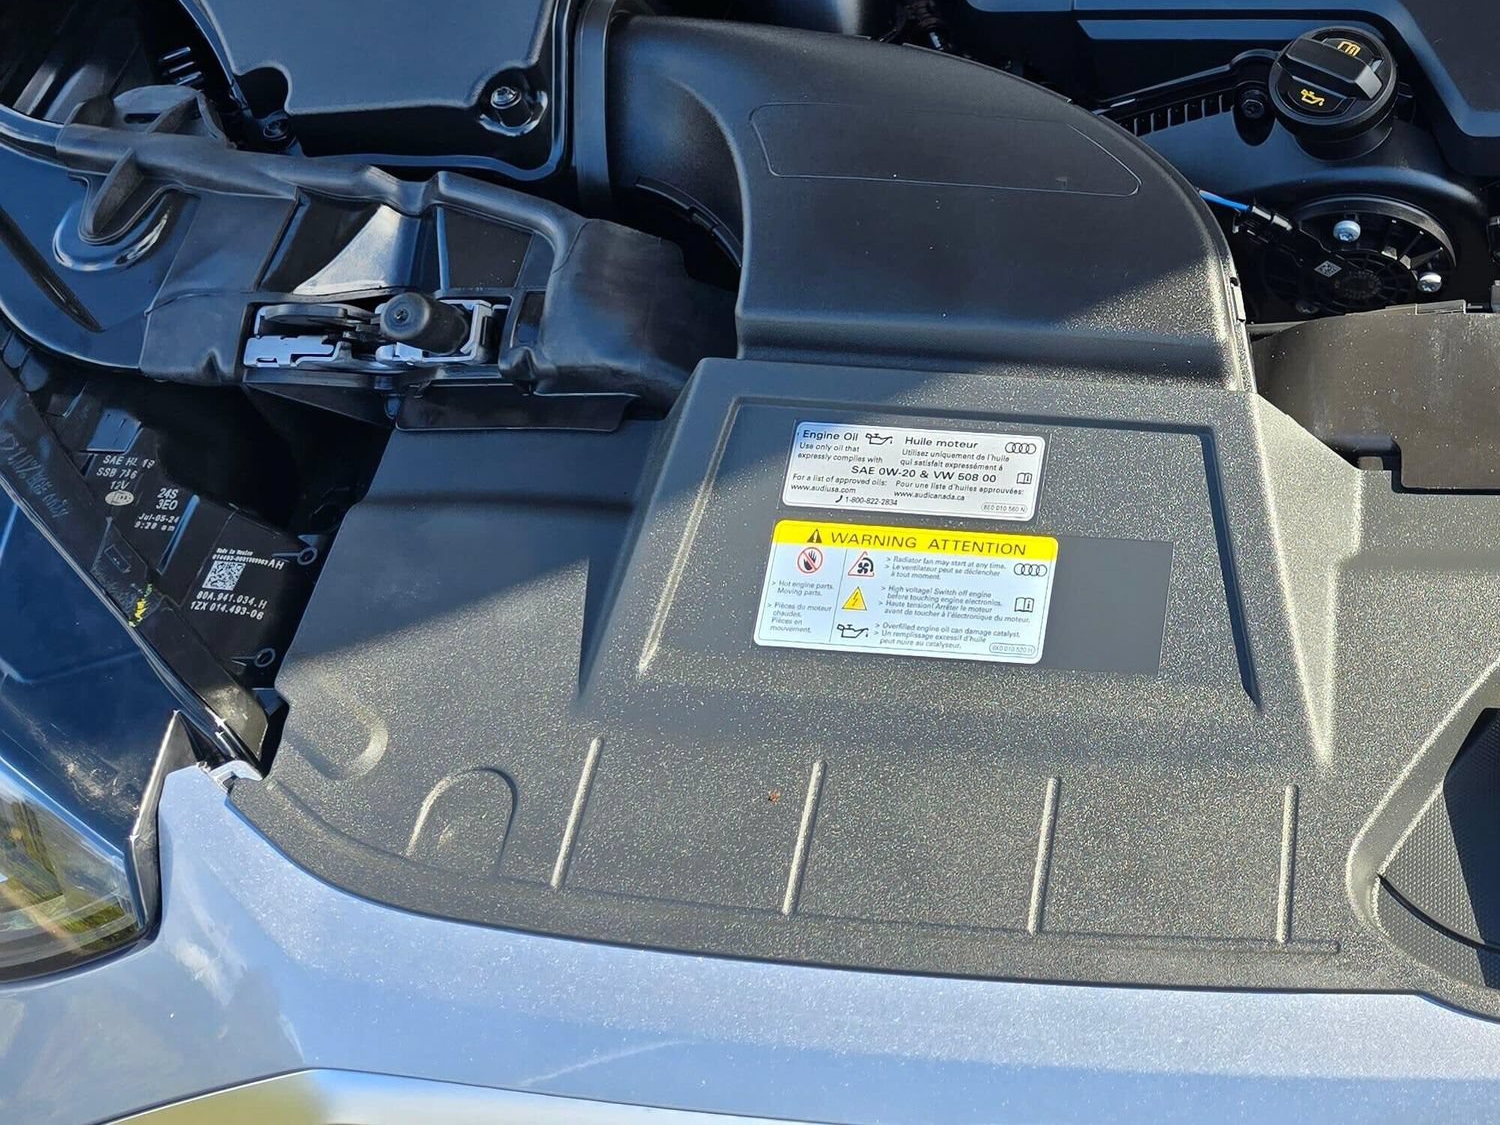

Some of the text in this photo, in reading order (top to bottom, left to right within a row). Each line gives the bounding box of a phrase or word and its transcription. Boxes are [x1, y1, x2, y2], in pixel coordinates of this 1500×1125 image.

[803, 429, 859, 441] Engine Oil
[816, 443, 832, 452] only
[904, 436, 979, 449] Huile moteur
[103, 454, 124, 466] SAE
[797, 452, 883, 464] expressly complies with
[901, 448, 1010, 462] Utilisez uniquement de l'huile
[913, 459, 943, 468] satisfait
[944, 462, 997, 471] expressément
[96, 467, 117, 477] SSB
[851, 465, 997, 483] SAE 0W-20 & VW 508 00
[110, 480, 130, 490] 12V
[792, 473, 805, 481] For
[825, 475, 834, 483] of
[835, 477, 870, 486] approved
[790, 484, 856, 494] www.audiusa.com
[895, 480, 914, 488] Pour
[930, 482, 946, 490] liste
[948, 483, 977, 492] d'huiles
[978, 486, 1025, 495] approuvées:
[157, 488, 179, 499] 24S
[893, 491, 965, 501] www.audicanada.ca
[845, 496, 898, 506] 1-800-822-2834
[138, 513, 180, 523] Jul-05-24
[831, 532, 1026, 555] WARNING ATTENTION
[268, 558, 285, 570] AH
[893, 556, 921, 564] Radiator
[923, 557, 934, 565] fan
[935, 558, 949, 566] may
[938, 566, 954, 574] peut
[964, 568, 1000, 576] déclencher
[778, 580, 835, 591] Hot engine parts.
[888, 585, 904, 593] High
[905, 587, 933, 595] voltage!
[934, 588, 957, 596] Switch
[777, 588, 804, 596] Moving
[196, 591, 267, 609] 80A.941.034.H
[885, 600, 905, 608] Haute
[935, 602, 959, 611] Arrêter
[910, 594, 939, 603] touching
[940, 596, 964, 604] engine
[964, 597, 1003, 606] electronics.
[190, 601, 264, 620] 1ZX 014.493-06
[774, 601, 832, 612] Pièces du moteur
[947, 611, 993, 622] l'électronique
[770, 625, 812, 633] mouvement.
[882, 622, 915, 631] Overfilled
[916, 625, 939, 633] engine
[964, 628, 992, 636] damage
[993, 629, 1020, 638] catalyst.
[893, 631, 933, 640] remplissage
[934, 633, 962, 641] excessif
[925, 640, 962, 649] catalyseur.
